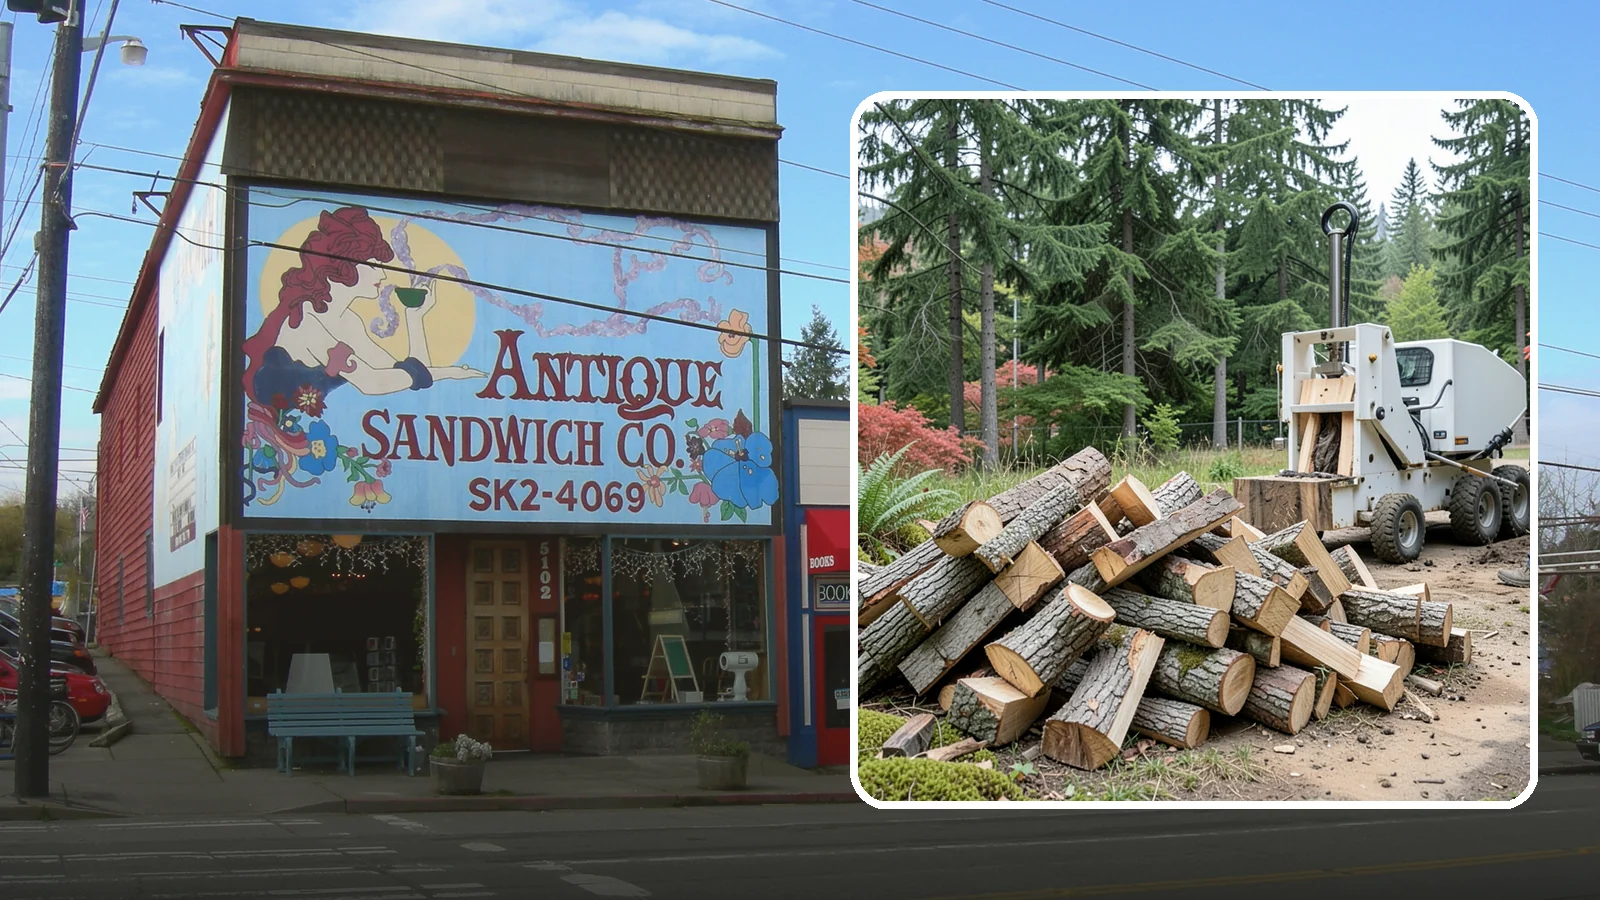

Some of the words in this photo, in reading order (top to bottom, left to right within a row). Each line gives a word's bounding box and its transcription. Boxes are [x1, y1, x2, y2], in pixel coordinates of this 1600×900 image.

[476, 329, 723, 420] ANTIQUE
[361, 408, 604, 467] SANDWICH
[617, 420, 685, 469] CO.
[468, 477, 646, 512] SK2-4069
[540, 542, 551, 599] 5102
[809, 555, 835, 569] BOOKS
